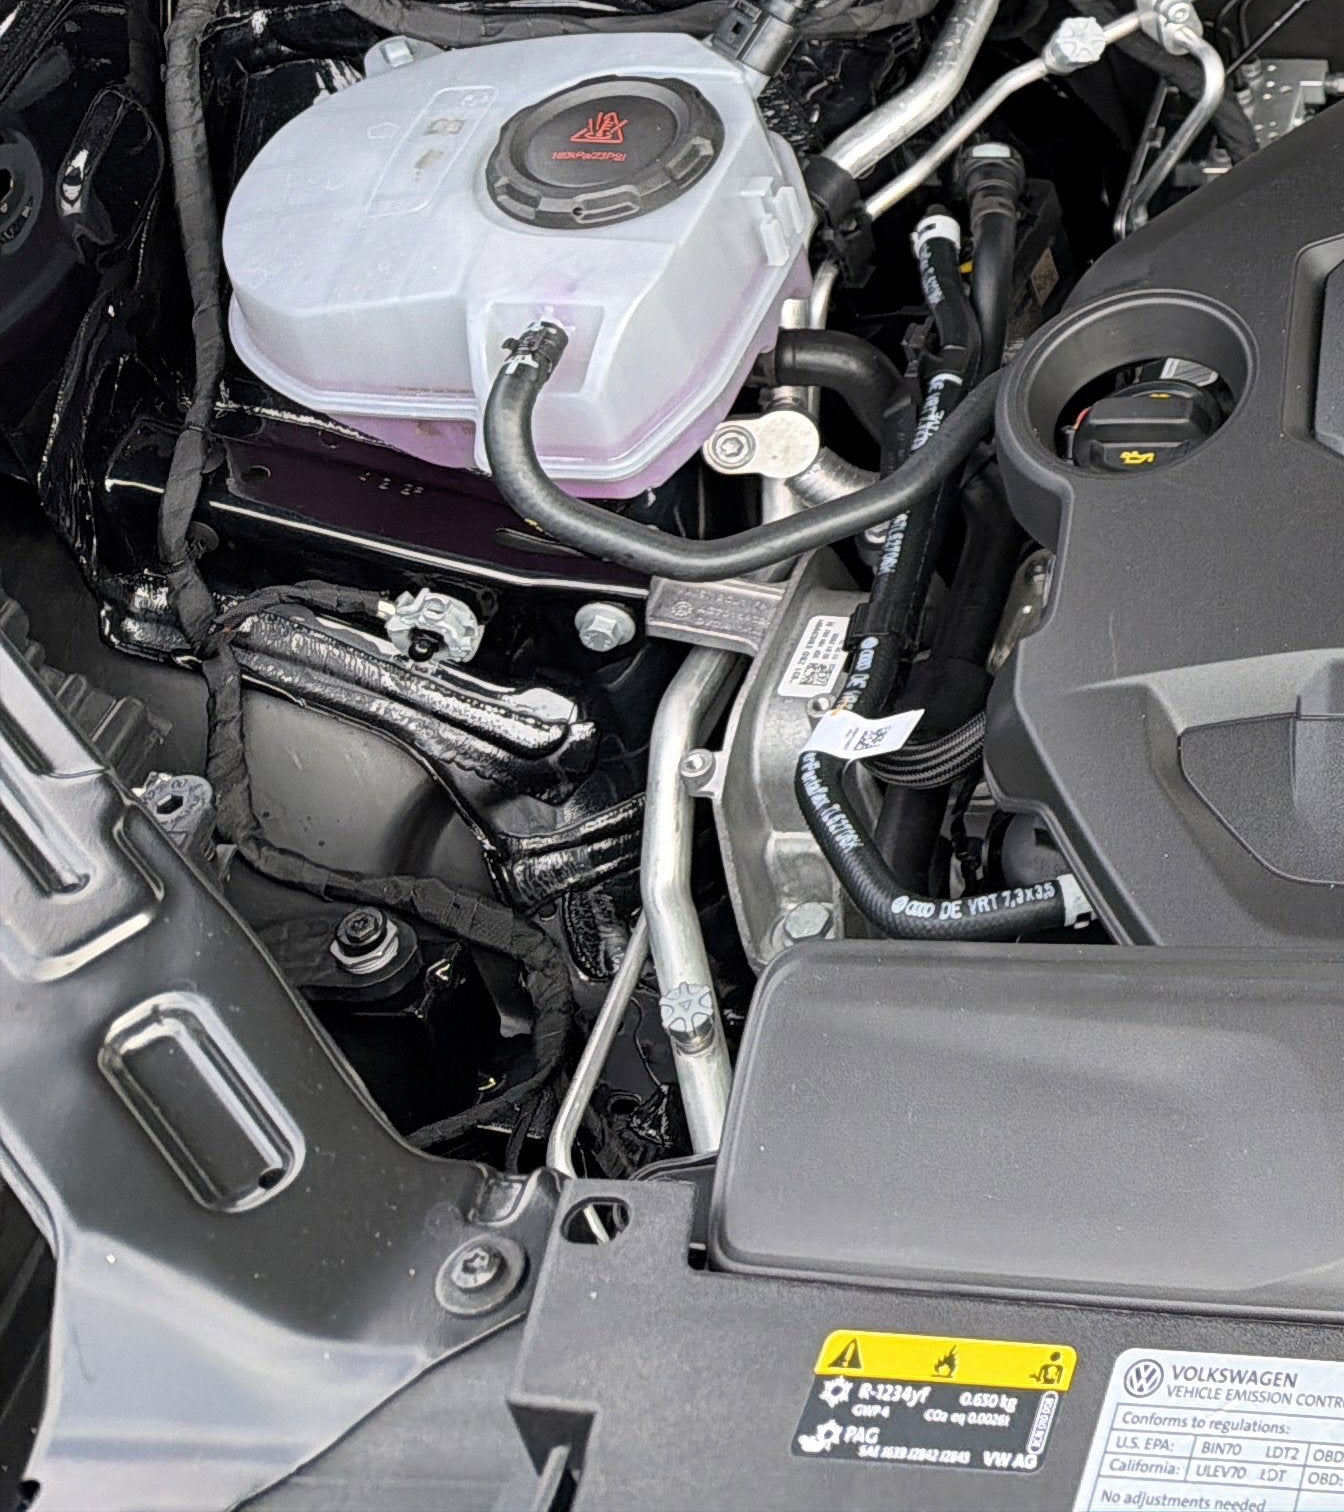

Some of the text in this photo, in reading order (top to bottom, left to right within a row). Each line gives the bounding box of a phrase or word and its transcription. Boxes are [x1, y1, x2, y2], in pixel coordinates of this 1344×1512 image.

[938, 899, 963, 920] DE
[967, 893, 999, 916] VRT
[1171, 1365, 1298, 1389] VOLKSWAGEN
[858, 1383, 1018, 1413] R-1234yf 0.650 kg
[1167, 1387, 1222, 1403] VEHICLE
[1225, 1389, 1293, 1405] EMISSION
[1121, 1411, 1291, 1438] Conforms to regulations:
[843, 1426, 880, 1444] PAG
[1115, 1437, 1175, 1453] U.S. EPA:
[1201, 1442, 1242, 1457] BIN70
[1265, 1445, 1299, 1461] LDT2
[983, 1450, 1038, 1470] VW AG
[1109, 1458, 1181, 1476] California:
[1195, 1464, 1248, 1481] ULEV70
[1260, 1467, 1288, 1483] LDT
[1307, 1471, 1344, 1487] OBD:
[1101, 1490, 1266, 1512] No adjustments needed
